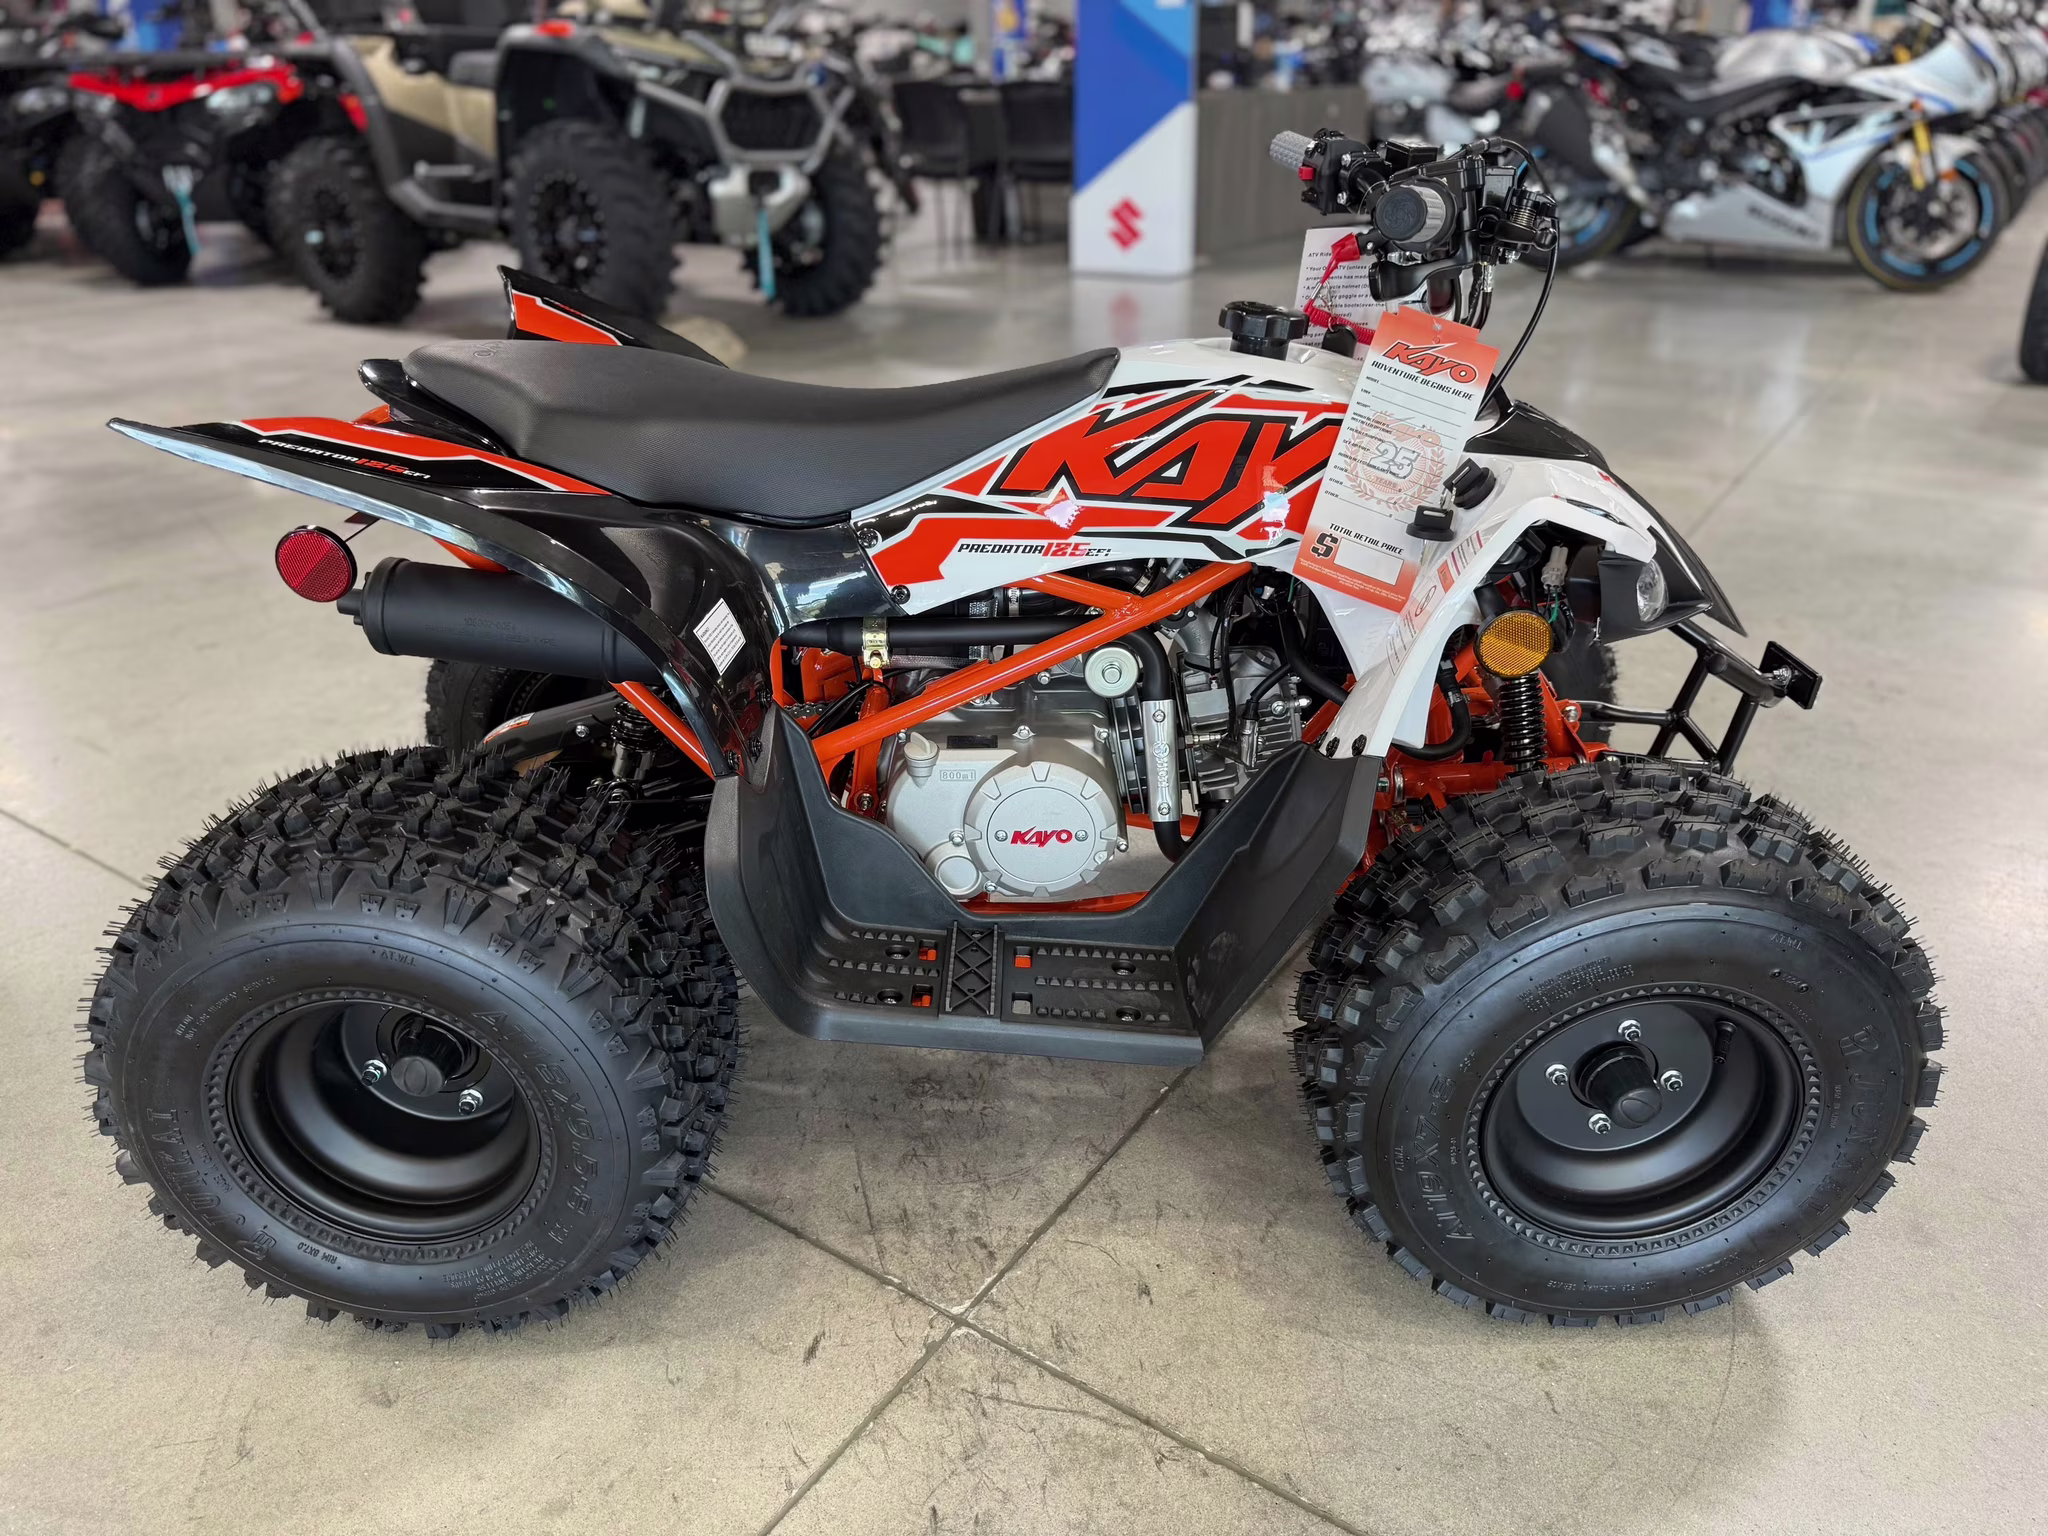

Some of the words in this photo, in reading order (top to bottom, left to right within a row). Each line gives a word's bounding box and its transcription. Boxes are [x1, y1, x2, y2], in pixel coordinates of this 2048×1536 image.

[1382, 340, 1478, 384] KAYO
[1371, 360, 1420, 382] ADVENTURE
[1420, 377, 1452, 394] BEGINS
[1451, 387, 1475, 401] HERE
[987, 389, 1342, 531] KAY
[1369, 440, 1421, 479] 25
[1310, 532, 1339, 559] $
[1328, 522, 1354, 539] TOTAL
[1353, 530, 1381, 547] RETAIL
[1380, 540, 1405, 556] PRICE
[942, 771, 974, 780] 800ml
[1010, 825, 1073, 848] KAYO
[320, 1251, 338, 1265] RIM
